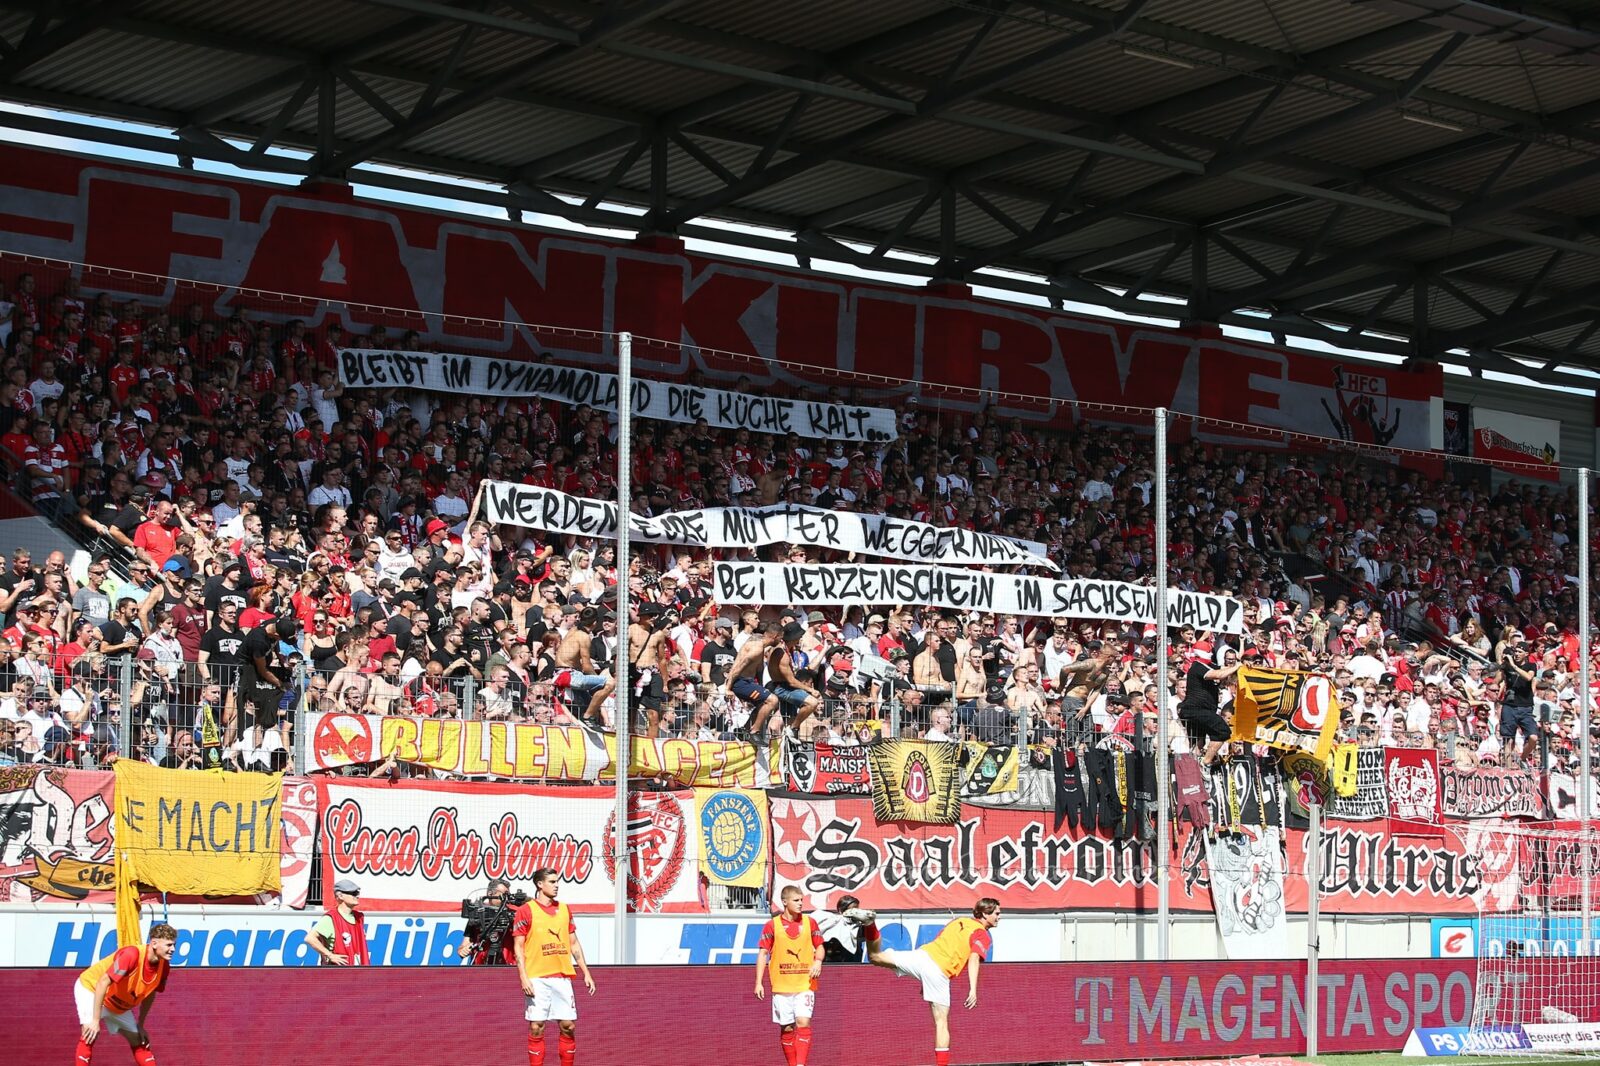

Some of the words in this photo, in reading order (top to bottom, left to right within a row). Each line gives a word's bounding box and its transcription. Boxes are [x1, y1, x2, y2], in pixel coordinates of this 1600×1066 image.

[1347, 373, 1379, 393] HFC
[718, 392, 792, 433] KÜCHE
[380, 717, 587, 781] BULLEN
[158, 796, 279, 853] MACHT
[326, 797, 420, 878] Coesa
[421, 806, 483, 882] Per
[1127, 970, 1376, 1044] MAGENTA
[1429, 1033, 1459, 1051] PS
[1460, 1031, 1521, 1051] UNION
[1528, 1031, 1573, 1044] bewegt
[1574, 1030, 1593, 1042] die
